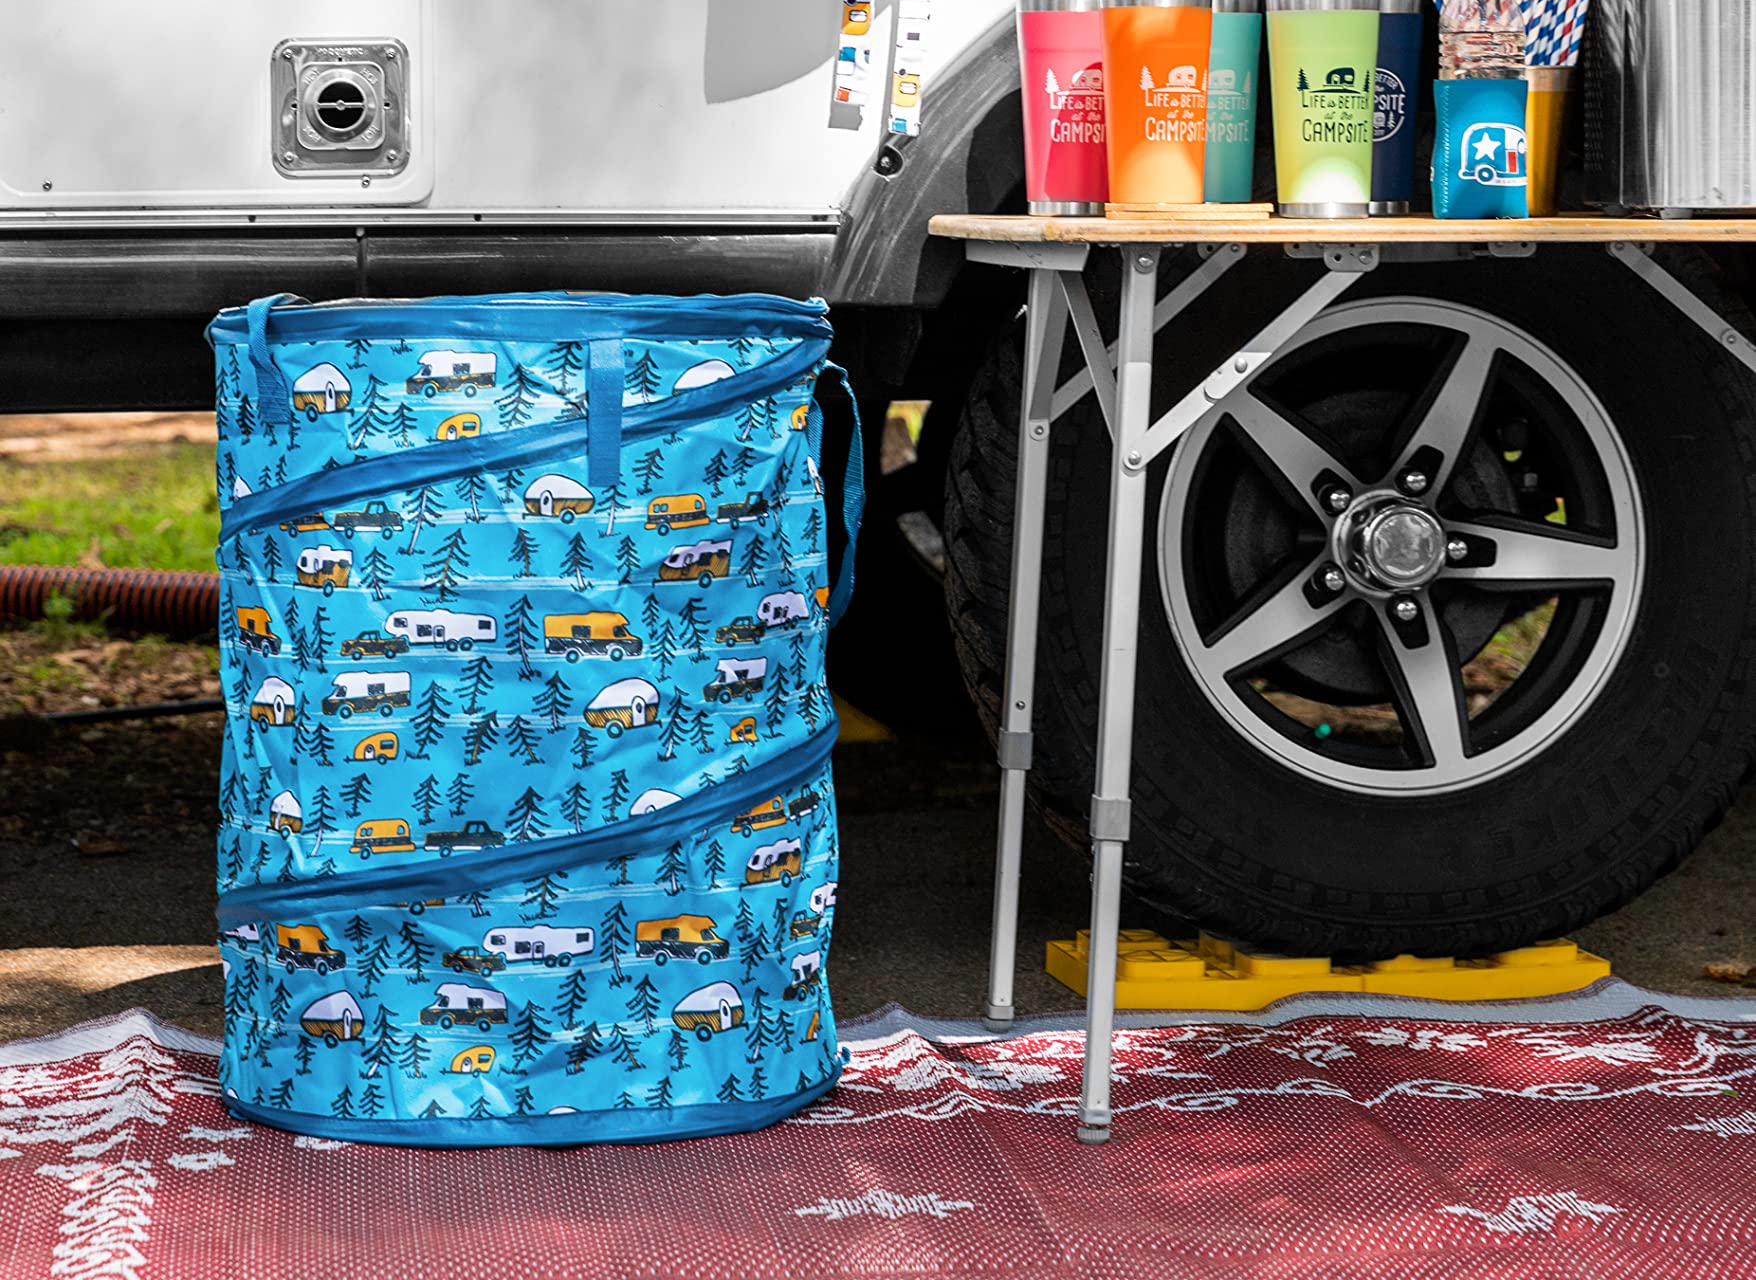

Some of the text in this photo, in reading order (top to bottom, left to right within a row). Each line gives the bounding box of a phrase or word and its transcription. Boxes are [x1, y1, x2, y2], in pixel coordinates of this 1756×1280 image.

[1084, 95, 1105, 111] BET
[1374, 93, 1406, 114] PSITE
[1050, 118, 1105, 144] CAMPSI
[1205, 119, 1249, 144] MPSITE
[1302, 118, 1369, 143] CAMPSITE
